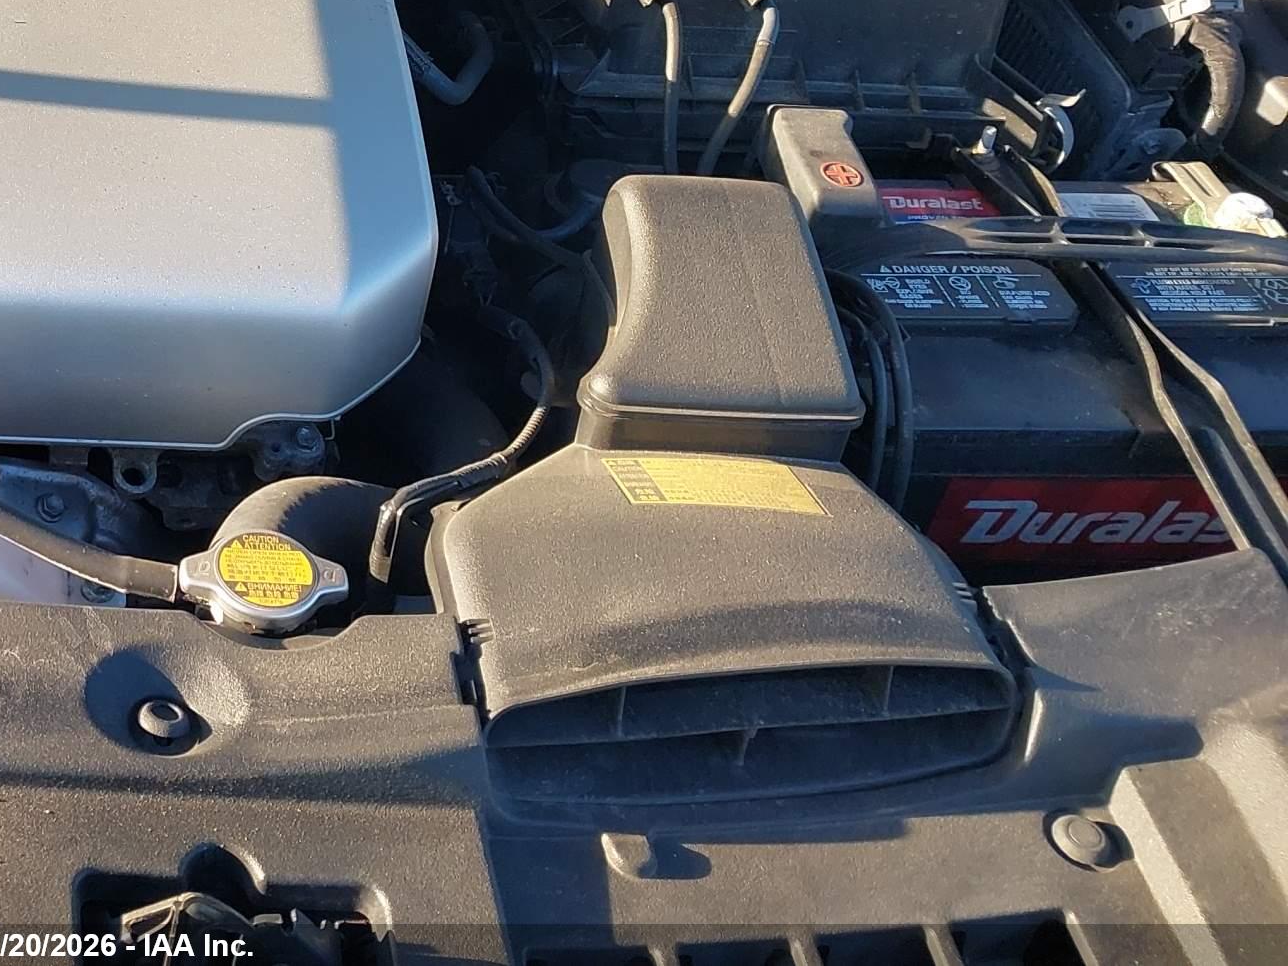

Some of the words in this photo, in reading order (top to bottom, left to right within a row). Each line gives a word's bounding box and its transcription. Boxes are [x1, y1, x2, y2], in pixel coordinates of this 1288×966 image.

[882, 196, 984, 210] Duralast
[892, 265, 949, 274] DANGER
[961, 265, 1013, 274] POISON
[960, 500, 1233, 544] Duralas
[242, 535, 280, 544] CAUTION
[244, 542, 292, 551] ATTENTION
